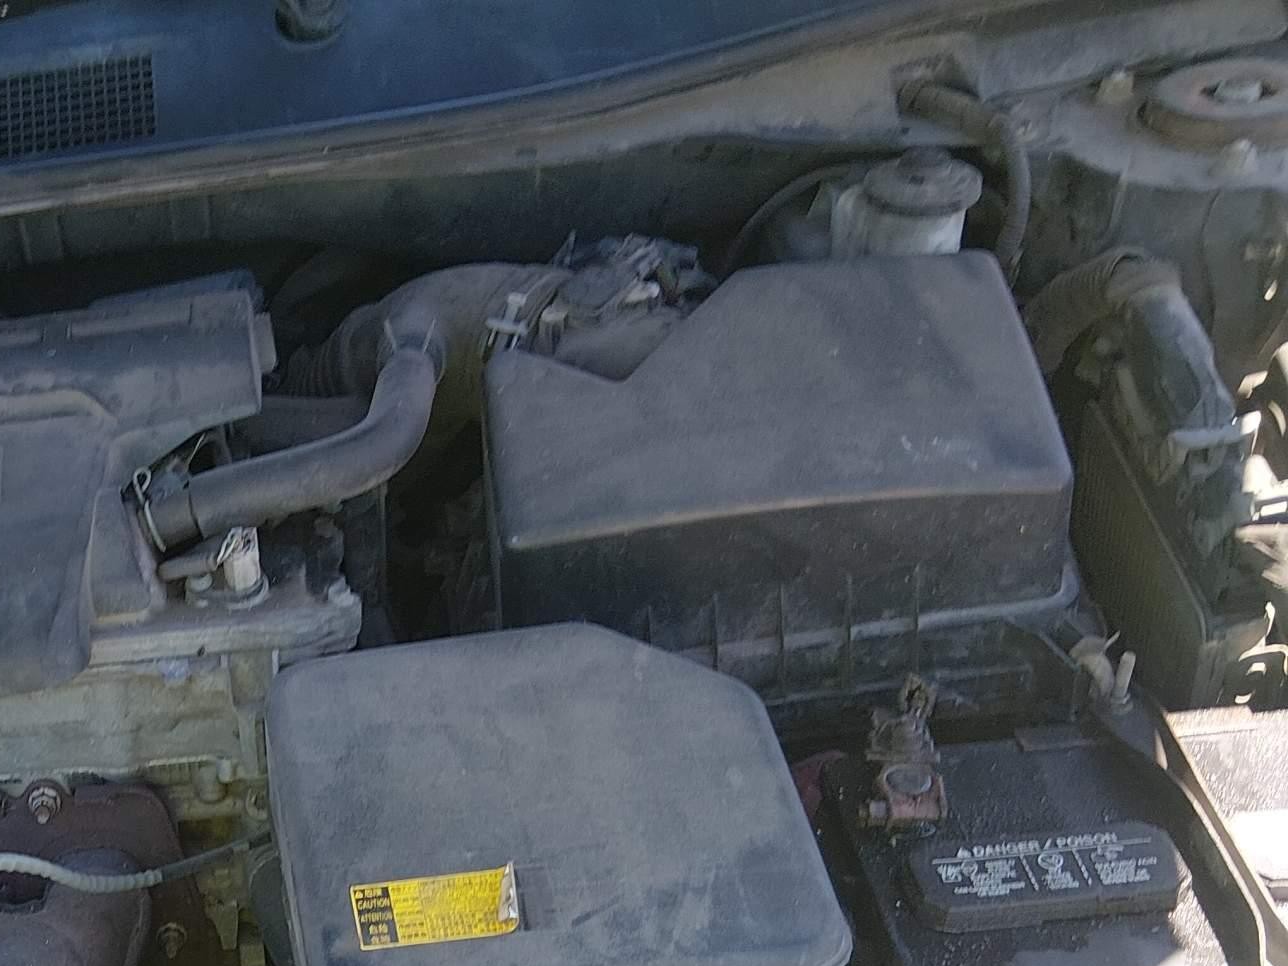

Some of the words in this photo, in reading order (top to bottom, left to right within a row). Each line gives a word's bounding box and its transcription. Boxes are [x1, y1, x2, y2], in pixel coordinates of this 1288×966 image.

[973, 840, 1040, 857] DANGER
[1056, 832, 1118, 848] POISON
[357, 897, 390, 911] CAUTION
[361, 911, 393, 923] ATTENTION
